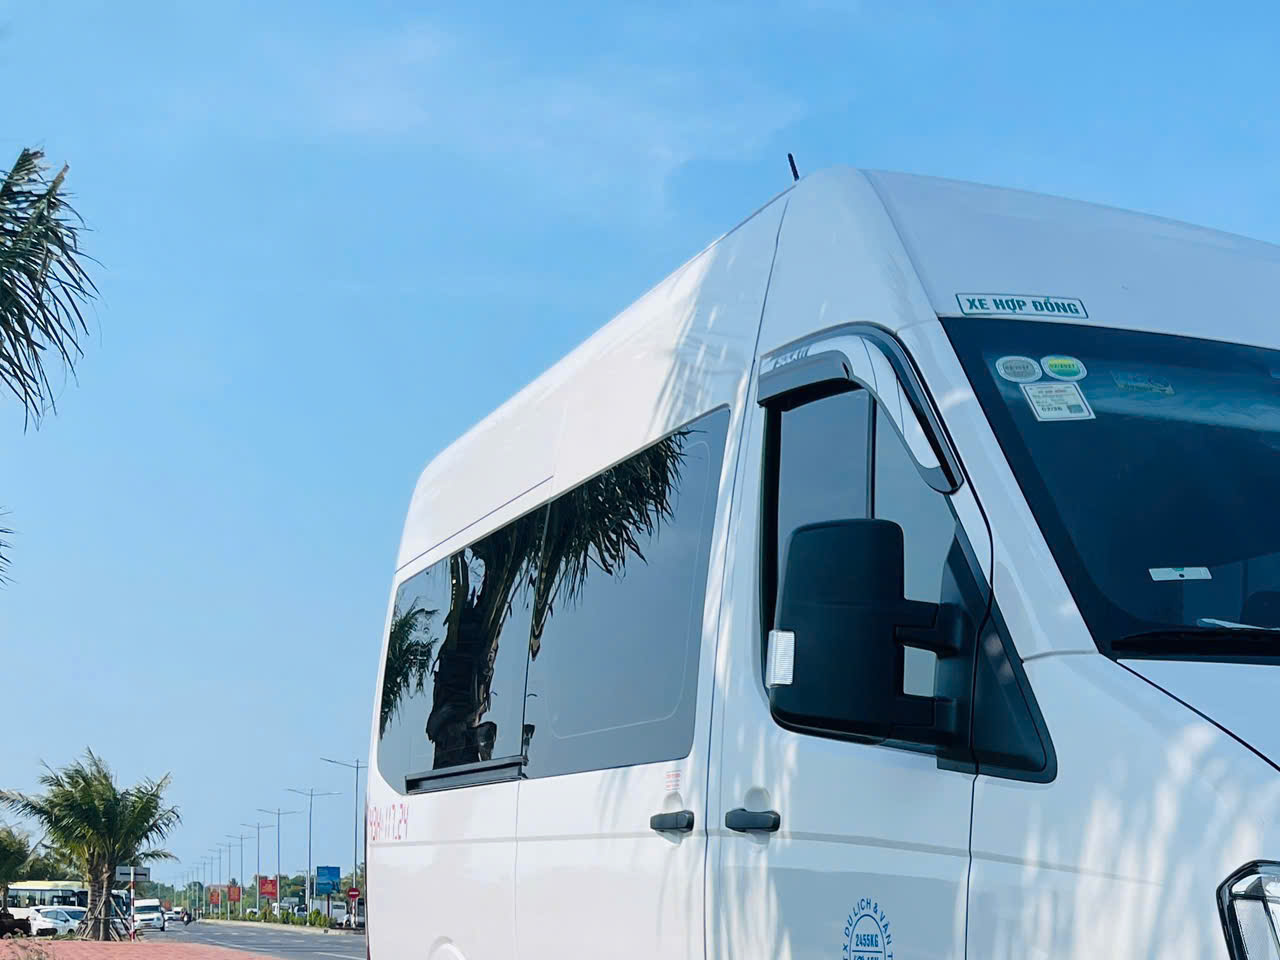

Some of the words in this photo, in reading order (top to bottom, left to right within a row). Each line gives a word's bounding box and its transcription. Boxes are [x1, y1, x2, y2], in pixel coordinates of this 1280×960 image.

[966, 298, 989, 310] XE
[992, 298, 1027, 313] HỢP
[1032, 296, 1080, 314] ĐỒNG
[844, 915, 854, 938] DU
[856, 934, 879, 948] 2455KG
